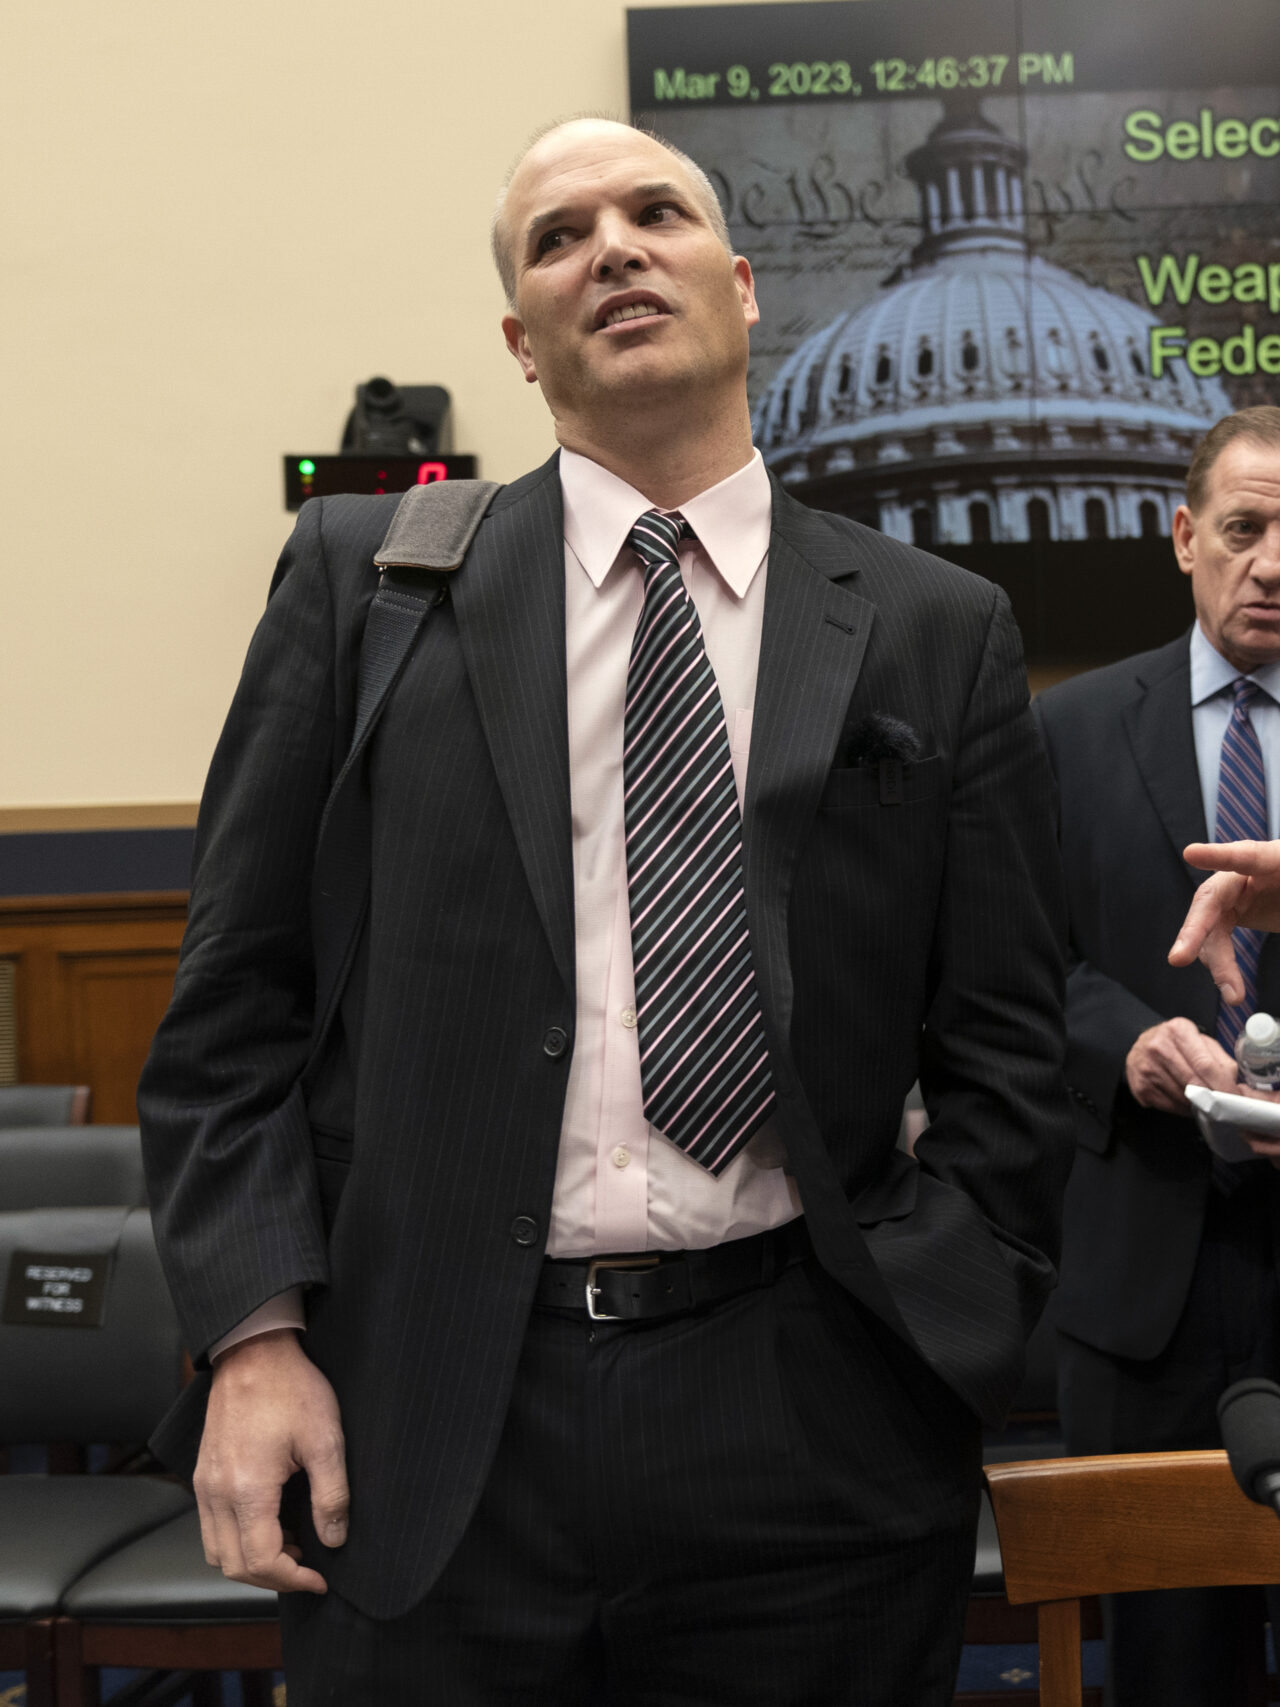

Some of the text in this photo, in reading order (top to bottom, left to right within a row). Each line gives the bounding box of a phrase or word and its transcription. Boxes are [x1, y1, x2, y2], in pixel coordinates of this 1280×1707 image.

[653, 51, 1074, 101] Mar 9, 2023, 12:46:37 PM
[25, 1265, 93, 1282] RESERVED
[42, 1281, 71, 1296] FOR
[26, 1297, 83, 1313] WITNESS
